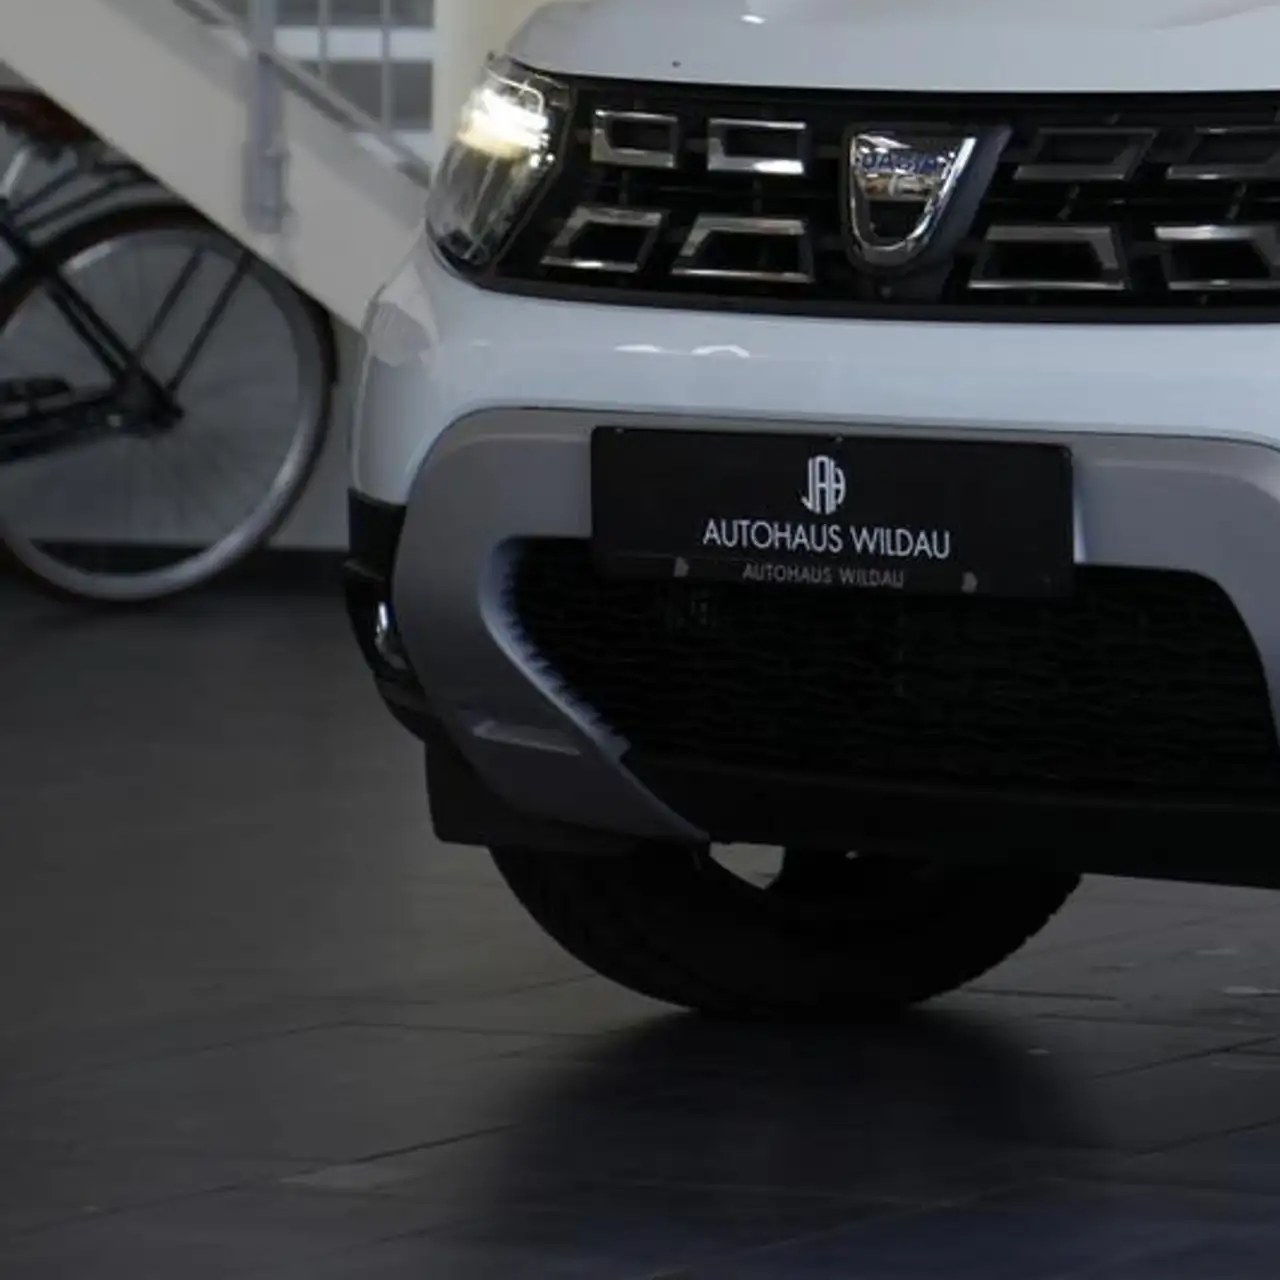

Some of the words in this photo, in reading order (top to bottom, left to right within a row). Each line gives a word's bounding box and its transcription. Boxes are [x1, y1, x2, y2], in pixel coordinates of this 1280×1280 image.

[703, 519, 843, 553] AUTOHAUS
[850, 526, 951, 559] WILDAU
[743, 563, 832, 584] AUTOHAUS
[840, 569, 904, 589] WILDAU
